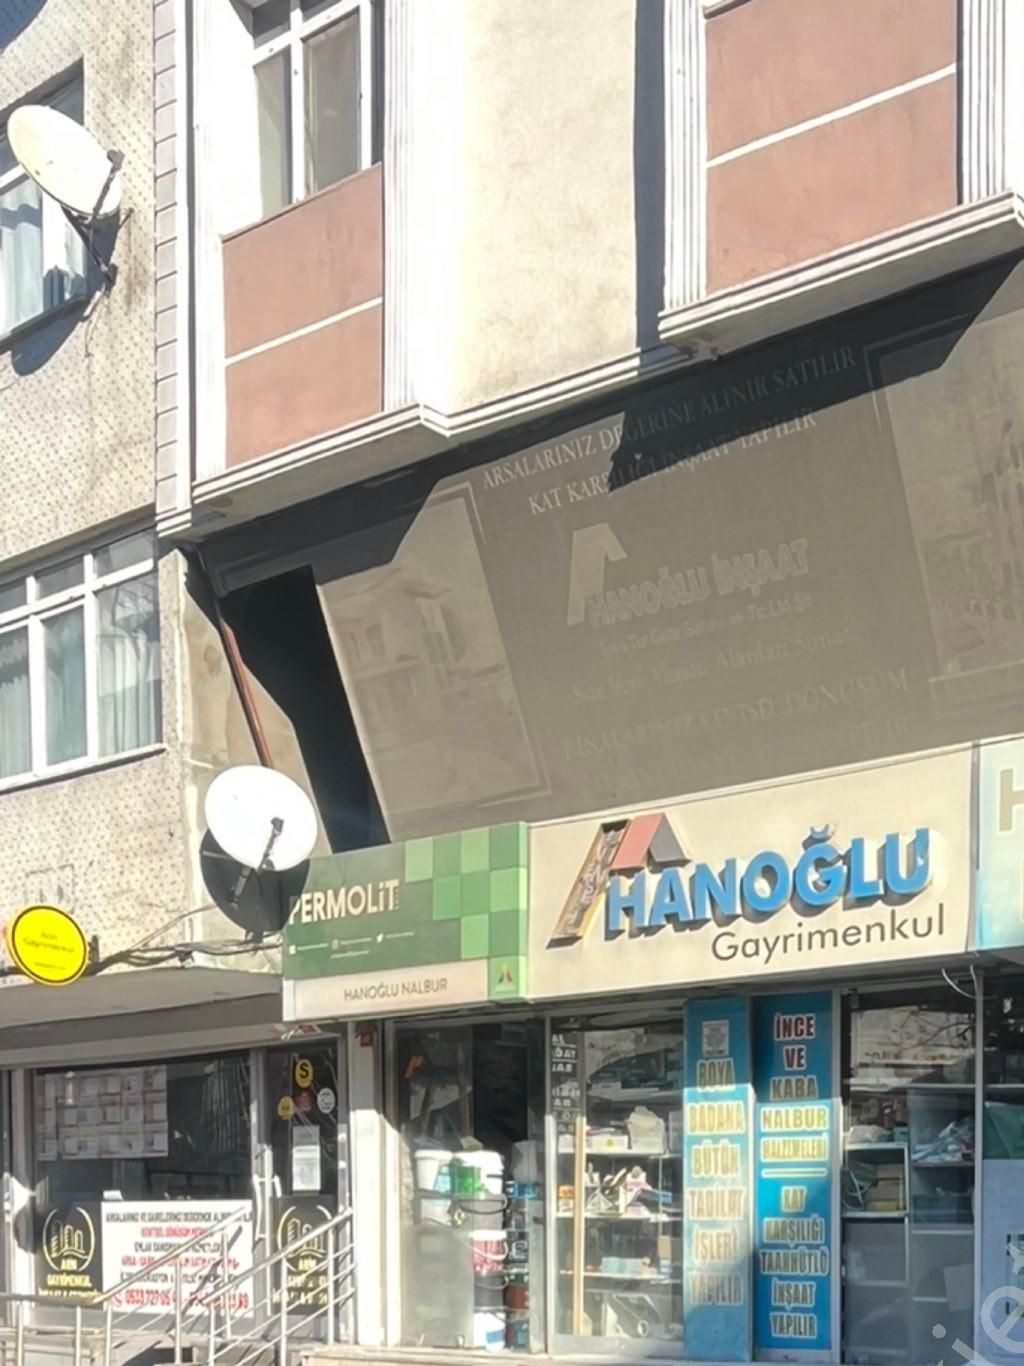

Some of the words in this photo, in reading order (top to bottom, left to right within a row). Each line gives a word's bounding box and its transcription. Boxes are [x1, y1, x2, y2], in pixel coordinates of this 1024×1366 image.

[482, 433, 599, 490] ARSALARINIZ
[700, 374, 770, 418] ALINIR
[774, 344, 857, 393] SATILIR
[528, 487, 561, 515] KAT
[604, 823, 931, 937] HANOĞLU
[711, 902, 944, 964] Gayrimenkul
[343, 980, 399, 1001] HANOĞLU
[401, 977, 448, 996] NALBUR
[774, 1012, 816, 1040] İNCE
[783, 1045, 806, 1070] VE
[697, 1058, 736, 1092] BOYA
[770, 1075, 818, 1101] KABA
[687, 1100, 745, 1136] BADANA
[761, 1105, 829, 1132] NALBUR
[691, 1139, 741, 1178] BÜTÜN
[781, 1185, 806, 1212] KAT
[763, 1213, 825, 1248] KARŞILIĞI
[771, 1277, 816, 1310] İNŞAAT
[770, 1312, 817, 1339] YAPILIR
